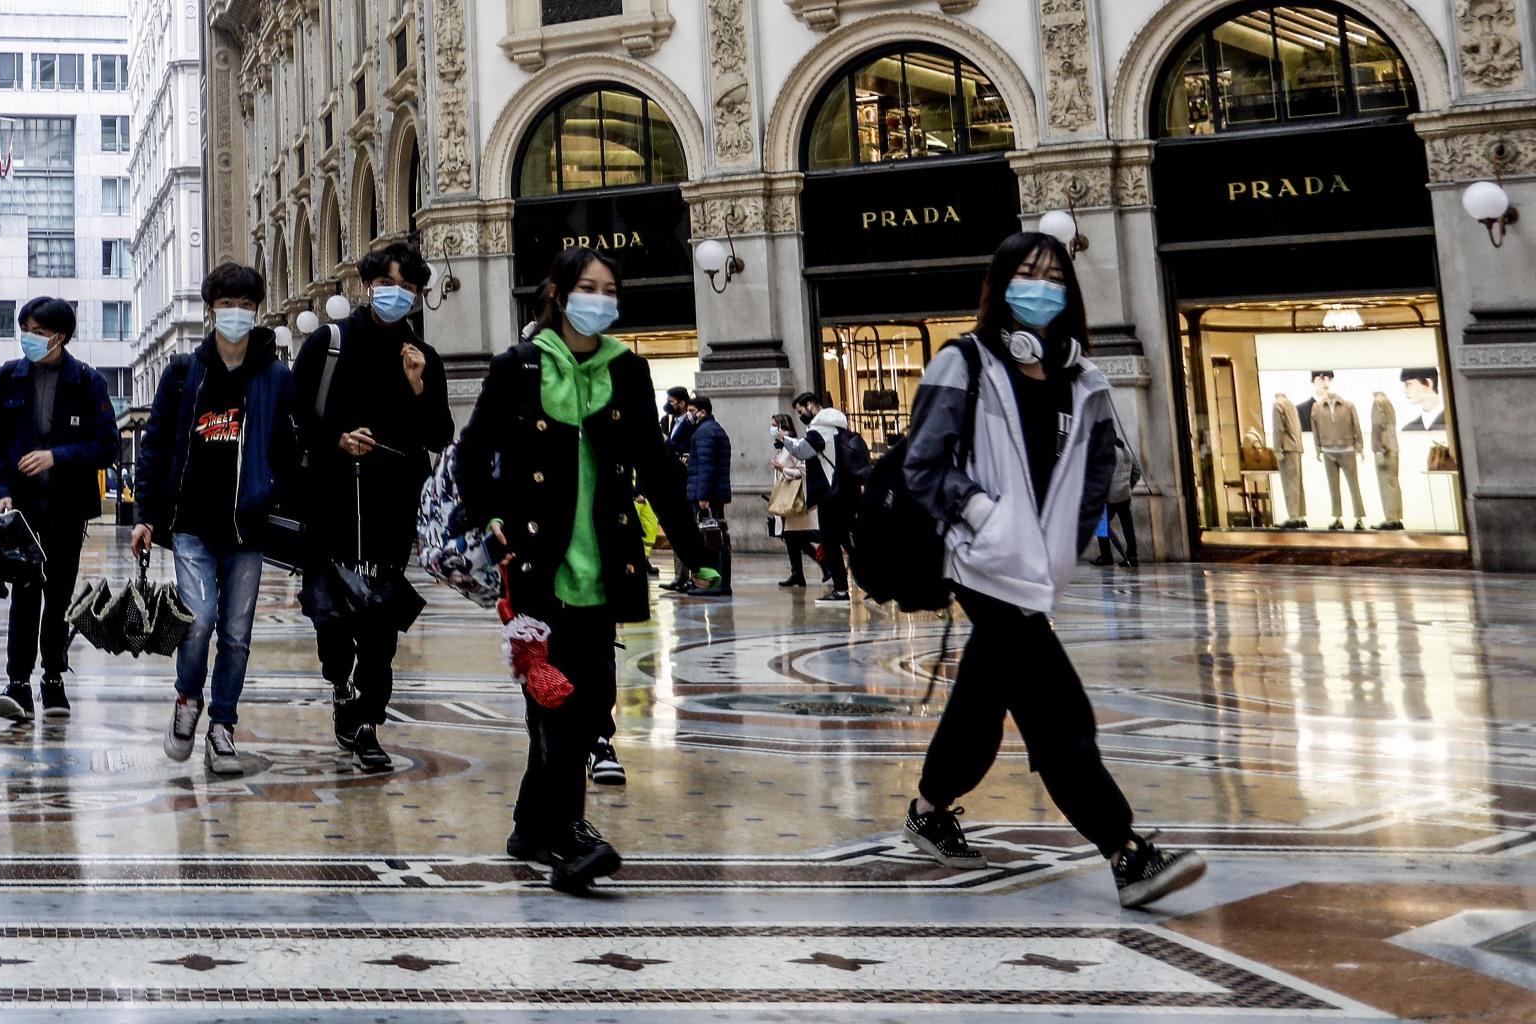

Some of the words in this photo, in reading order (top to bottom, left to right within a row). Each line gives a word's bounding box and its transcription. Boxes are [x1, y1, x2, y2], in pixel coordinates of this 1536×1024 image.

[1227, 174, 1351, 201] PRADA
[862, 205, 961, 229] PRADA
[562, 231, 644, 251] PRADA
[198, 421, 241, 443] FIGHTE
